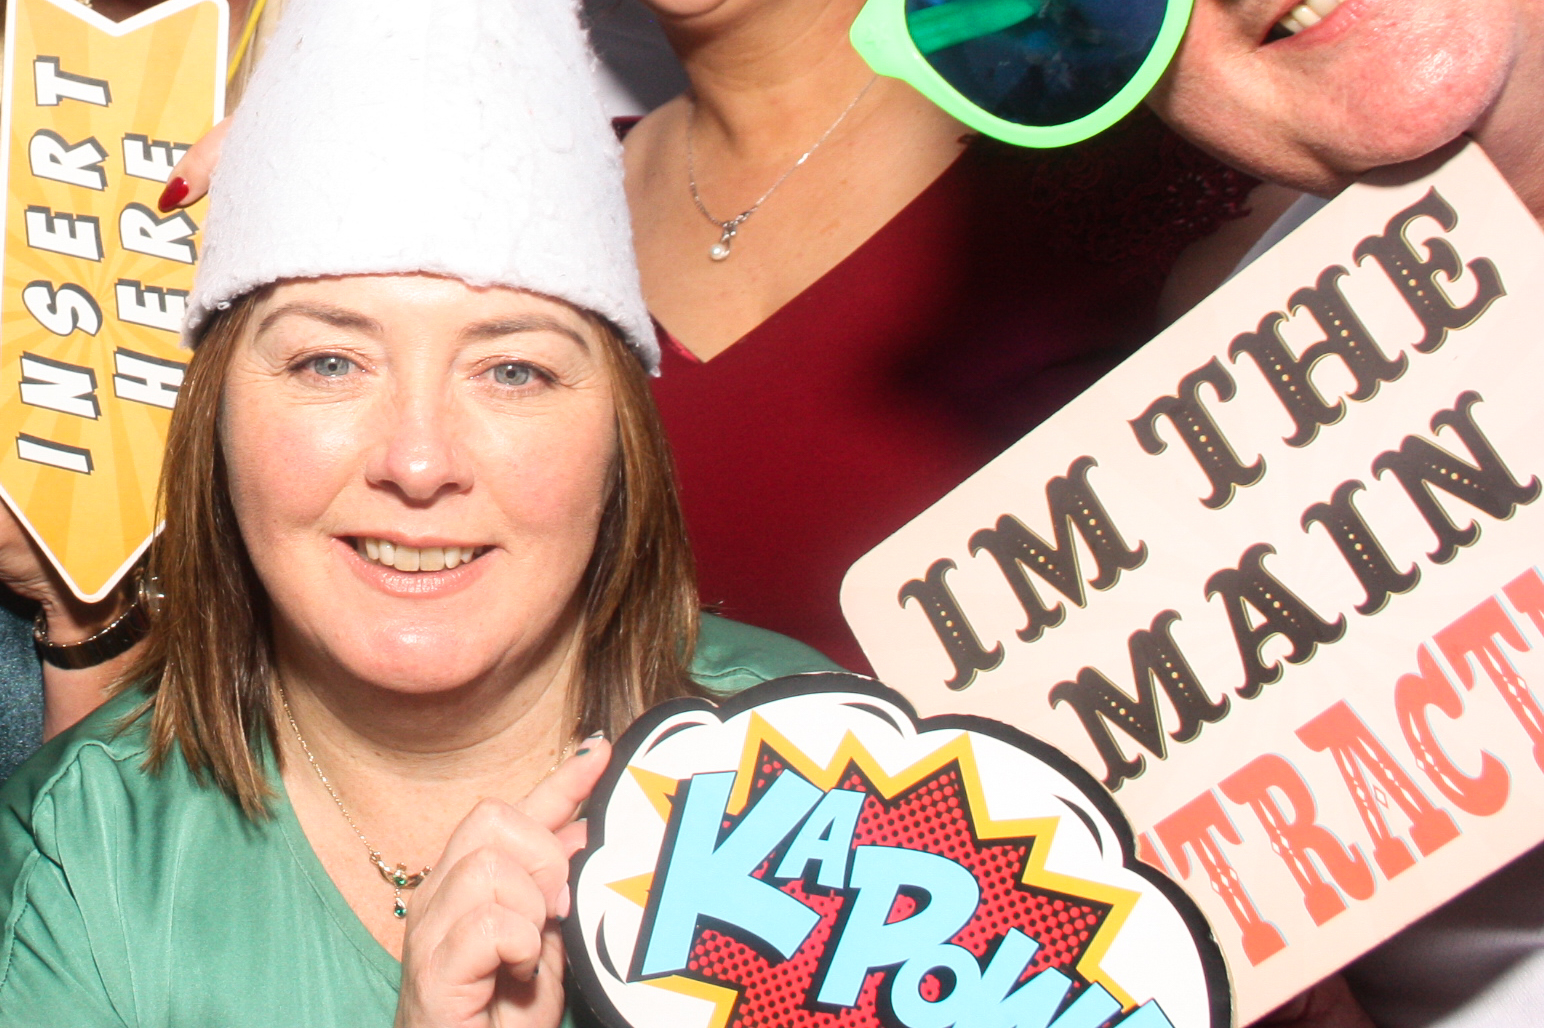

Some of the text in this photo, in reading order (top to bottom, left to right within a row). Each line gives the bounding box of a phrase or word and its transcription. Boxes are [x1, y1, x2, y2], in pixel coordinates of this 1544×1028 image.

[16, 55, 112, 475] INSERT
[112, 132, 199, 411] HERE
[897, 186, 1507, 690] IM THE
[1047, 389, 1542, 792] MAIN
[1136, 566, 1544, 968] TRACT
